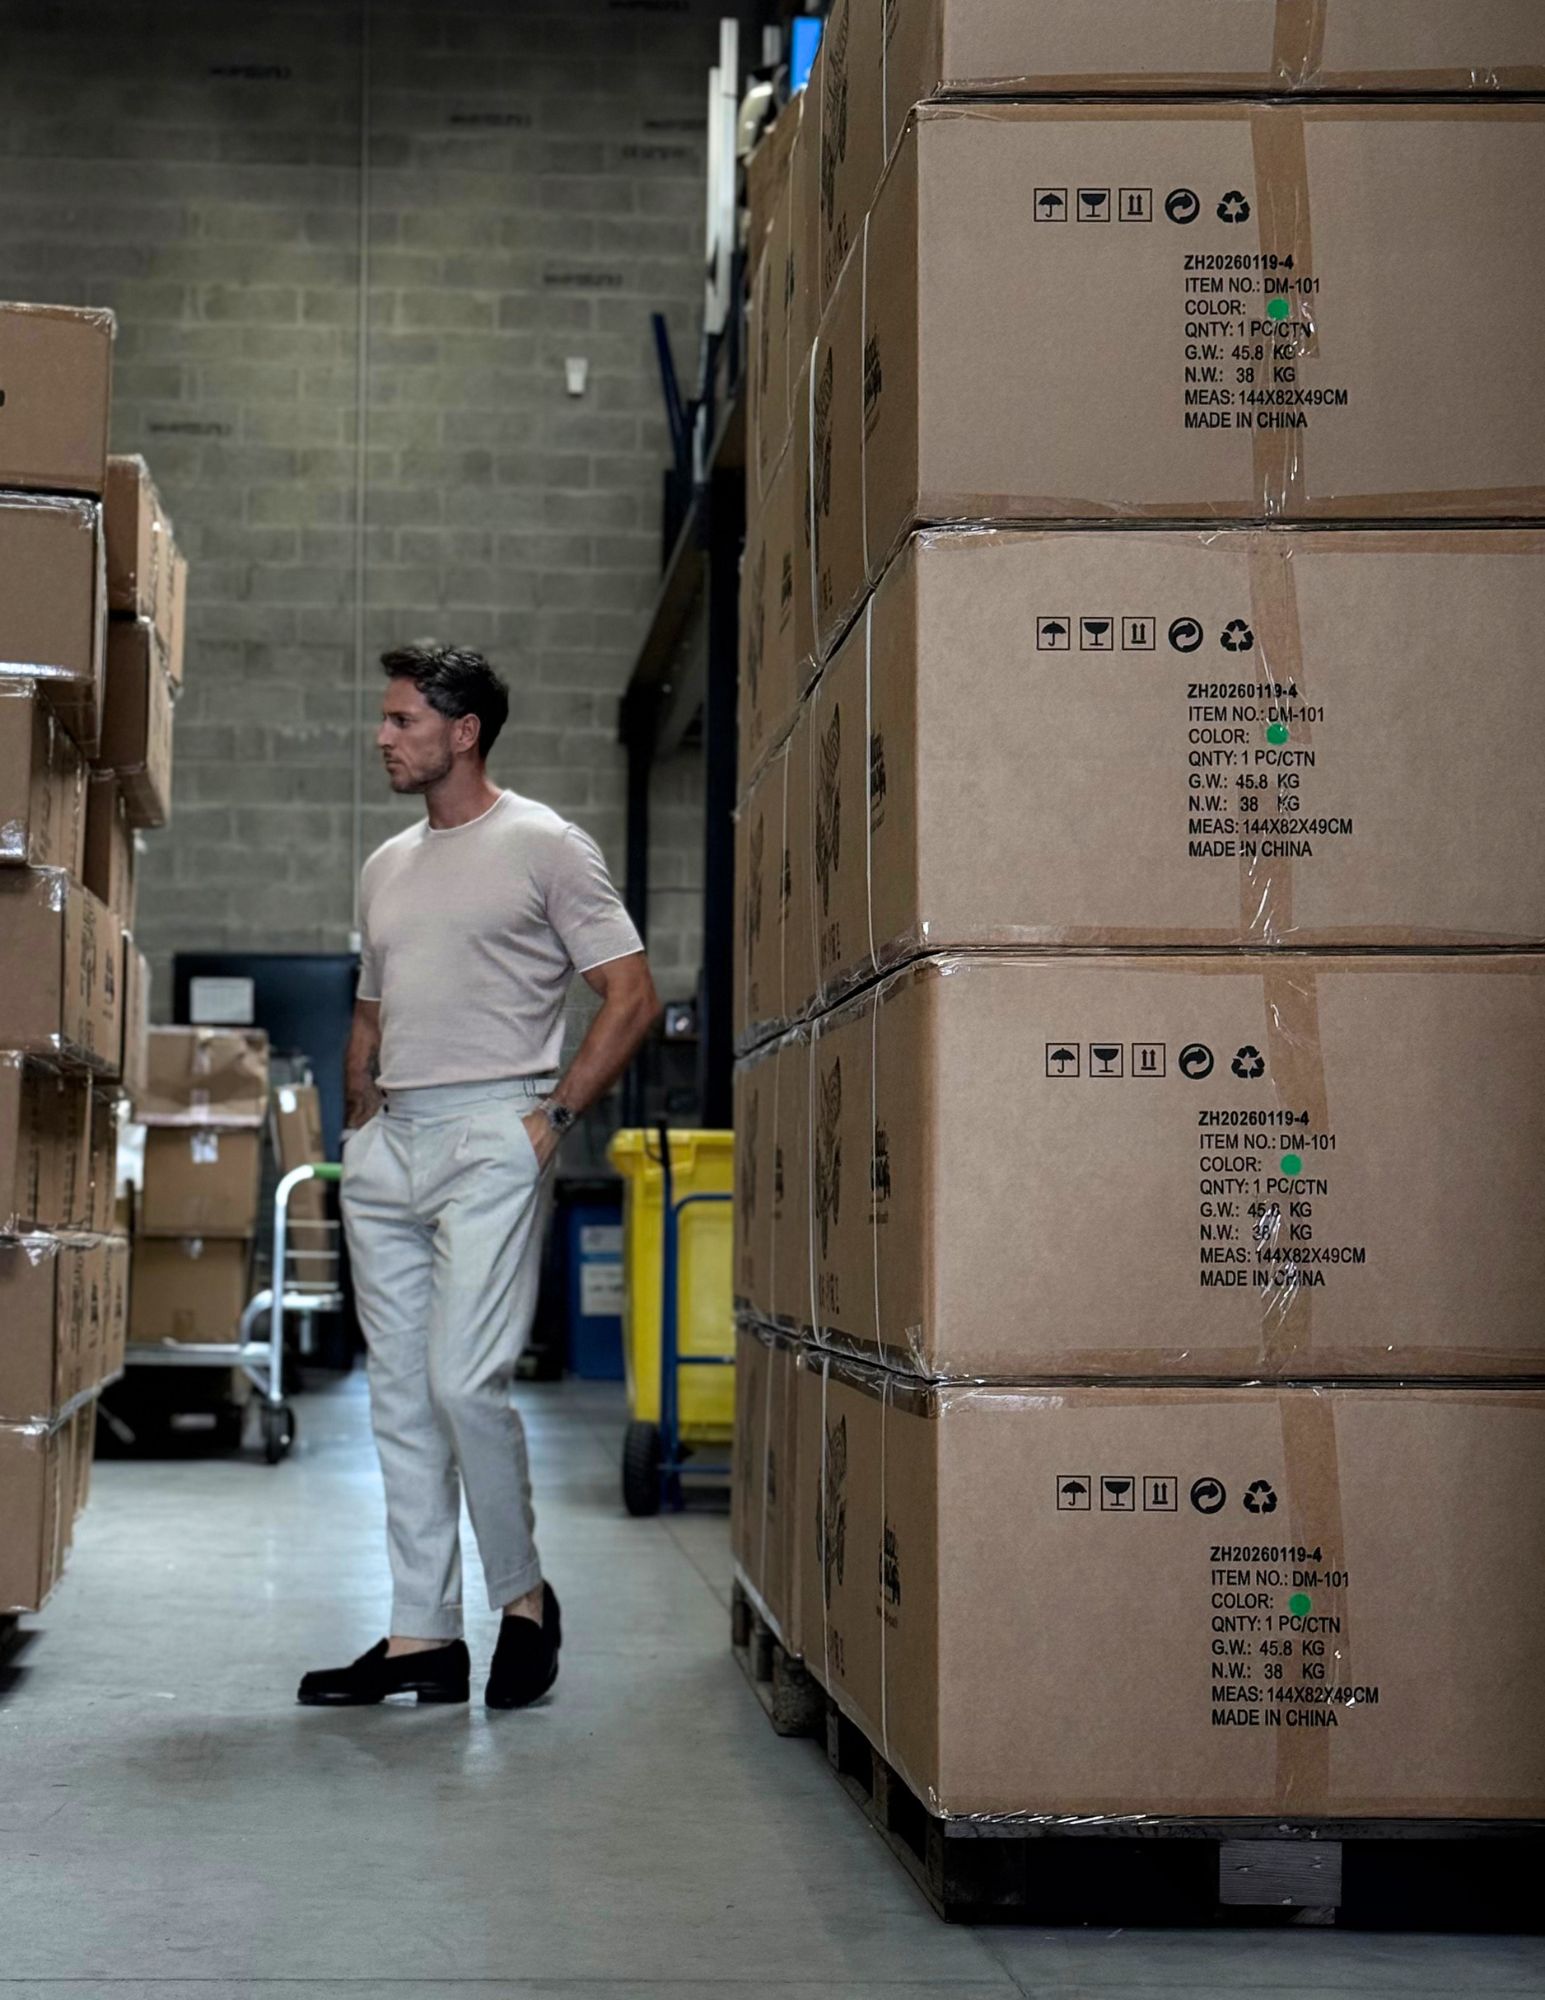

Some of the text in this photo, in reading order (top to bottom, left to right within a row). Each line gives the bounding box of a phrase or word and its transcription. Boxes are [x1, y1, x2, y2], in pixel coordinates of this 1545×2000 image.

[1184, 253, 1294, 270] ZH20260119-4
[1185, 277, 1320, 294] ITEM NO.: DM-101
[1185, 300, 1246, 316] COLOR:
[1185, 321, 1311, 338] QNTY: 1 PC/CTN
[1185, 344, 1295, 360] G.W.: 45.8 KG
[1185, 367, 1295, 382] N.W.: 38 KG
[1185, 389, 1348, 405] MEAS: 144X82X49CM
[1185, 411, 1308, 428] MADE IN CHINA
[1187, 683, 1298, 699] ZH20260119-4
[1189, 705, 1324, 722] ITEM NO.: DM-101
[1189, 728, 1249, 744] COLOR:
[1189, 749, 1315, 767] QNTY: 1 PC/CTN
[1189, 773, 1299, 789] G.W.: 45.8 KG
[1189, 795, 1299, 811] N.W.: 38 KG
[1189, 818, 1352, 834] MEAS: 144X82X49CM
[1189, 840, 1312, 857] MADE IN CHINA
[1198, 1110, 1309, 1126] ZH20260119-4
[1200, 1133, 1336, 1150] ITEM NO.: DM-101
[1200, 1156, 1262, 1172] COLOR:
[1200, 1177, 1328, 1195] QNTY: 1 PC/CTN
[1200, 1201, 1239, 1218] G.W.:
[1290, 1201, 1312, 1218] KG
[1200, 1223, 1239, 1240] N.W.:
[1290, 1223, 1312, 1240] KG
[1201, 1247, 1366, 1264] MEAS: 144X82X49CM
[1201, 1270, 1324, 1287] MADE IN CHINA
[1210, 1545, 1322, 1562] ZH20260119-4
[1212, 1570, 1349, 1587] ITEM NO.: DM-101
[1212, 1592, 1273, 1609] COLOR:
[1212, 1615, 1340, 1633] QNTY: 1 PC/CTN
[1212, 1639, 1324, 1656] G.W.: 45.8 KG
[1212, 1662, 1324, 1679] N.W.: 38 KG
[1212, 1685, 1378, 1703] MEAS: 144X82X49CM
[1212, 1709, 1338, 1726] MADE IN CHINA
